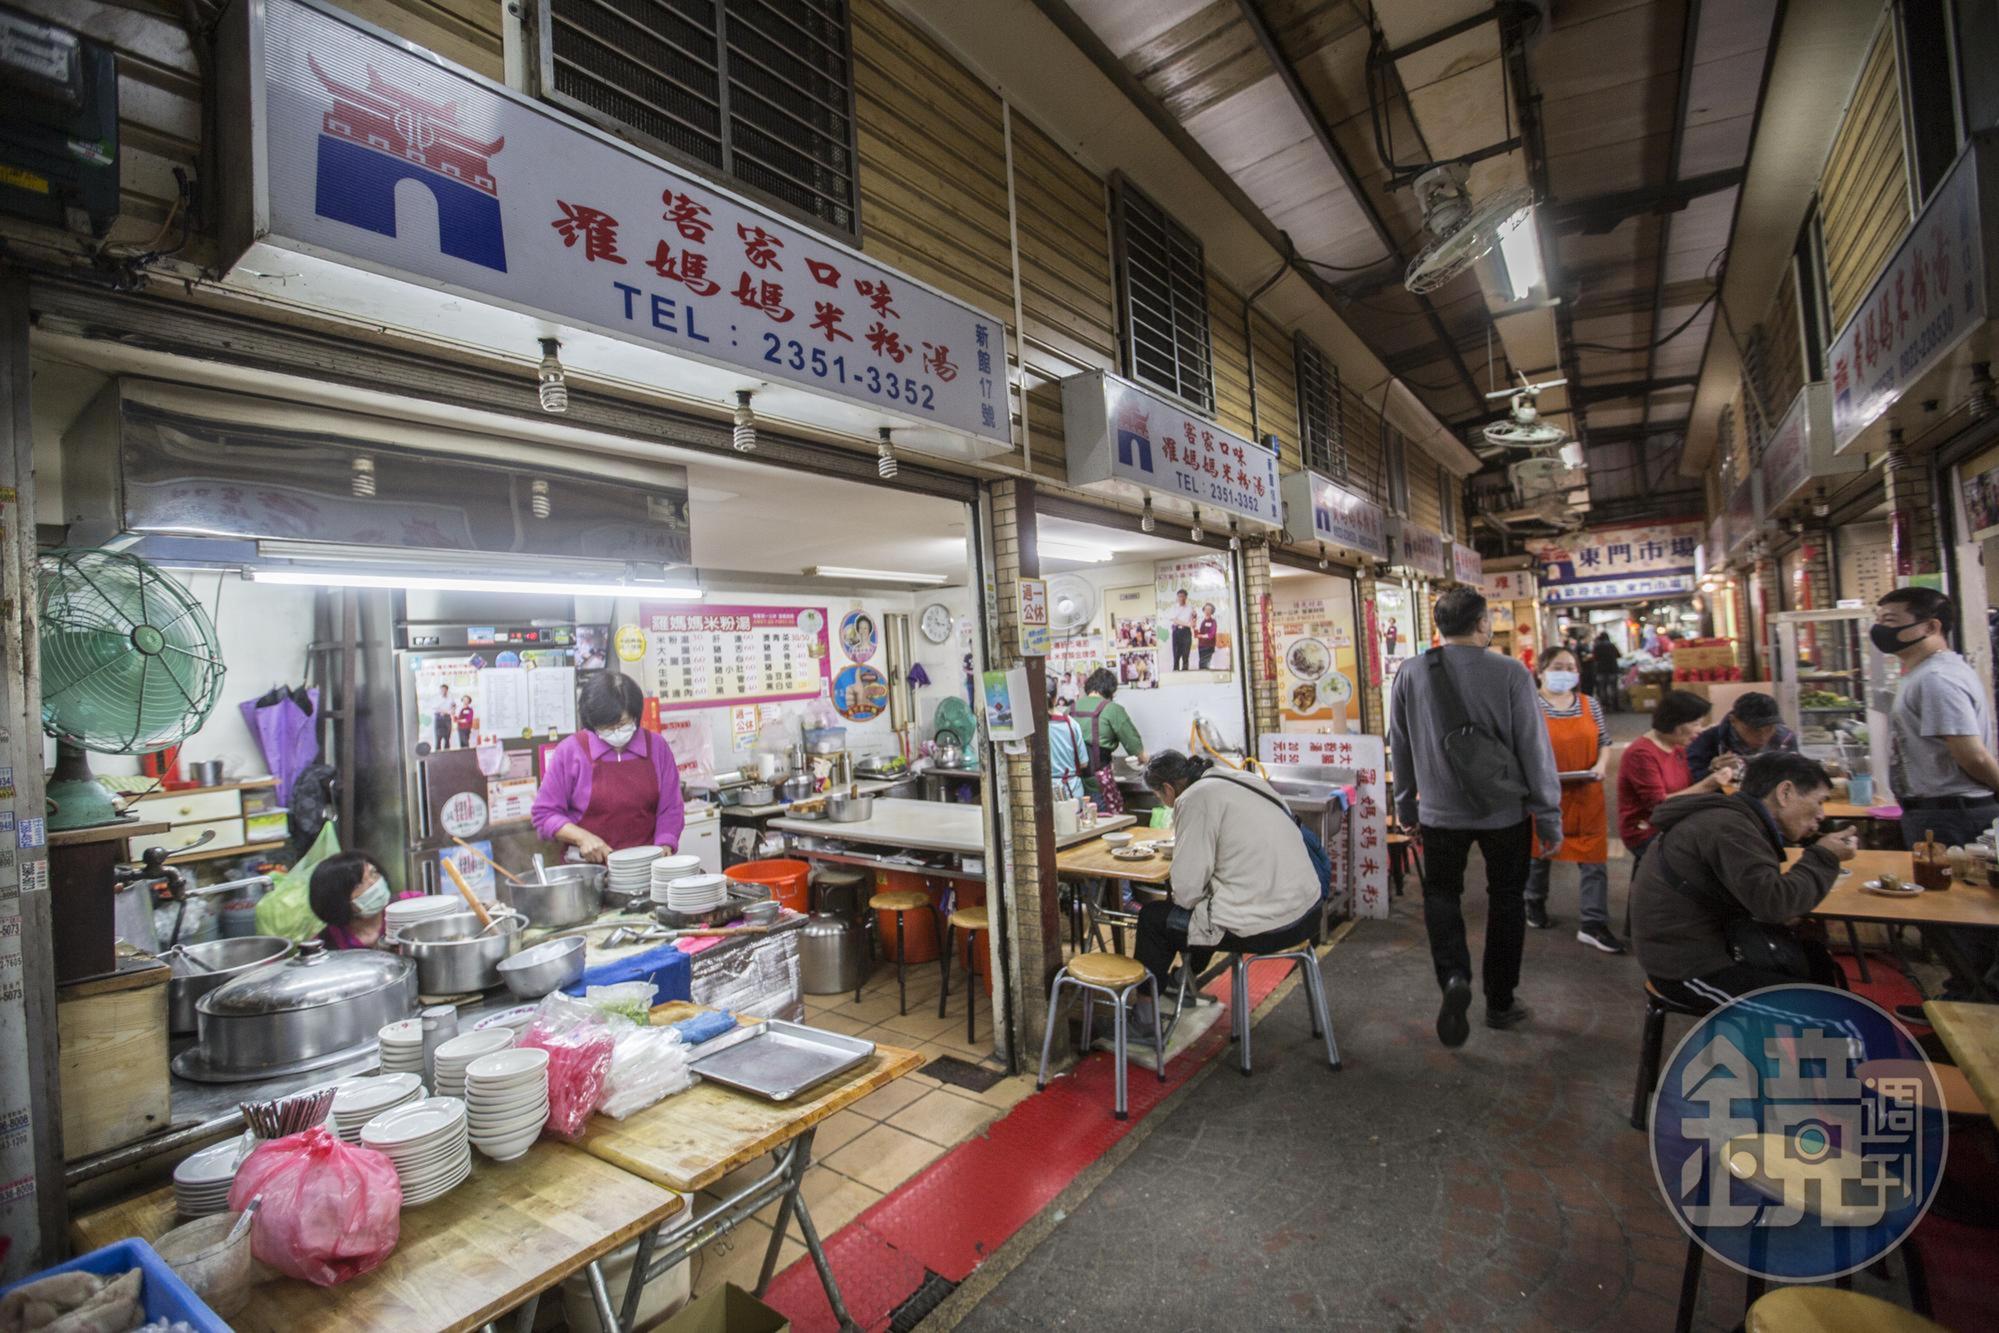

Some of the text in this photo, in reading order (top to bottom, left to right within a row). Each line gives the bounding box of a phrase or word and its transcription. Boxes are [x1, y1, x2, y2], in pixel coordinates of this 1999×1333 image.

[661, 188, 902, 320] 客家口味
[762, 331, 936, 411] 2351-3352
[975, 323, 996, 430] 新館17號
[1183, 420, 1247, 467] 客家口味
[1210, 482, 1259, 513] 2351-3352
[1579, 536, 1695, 567] 東門市場
[651, 615, 752, 632] 羅媽媽米粉湯
[1024, 604, 1044, 621] 公休
